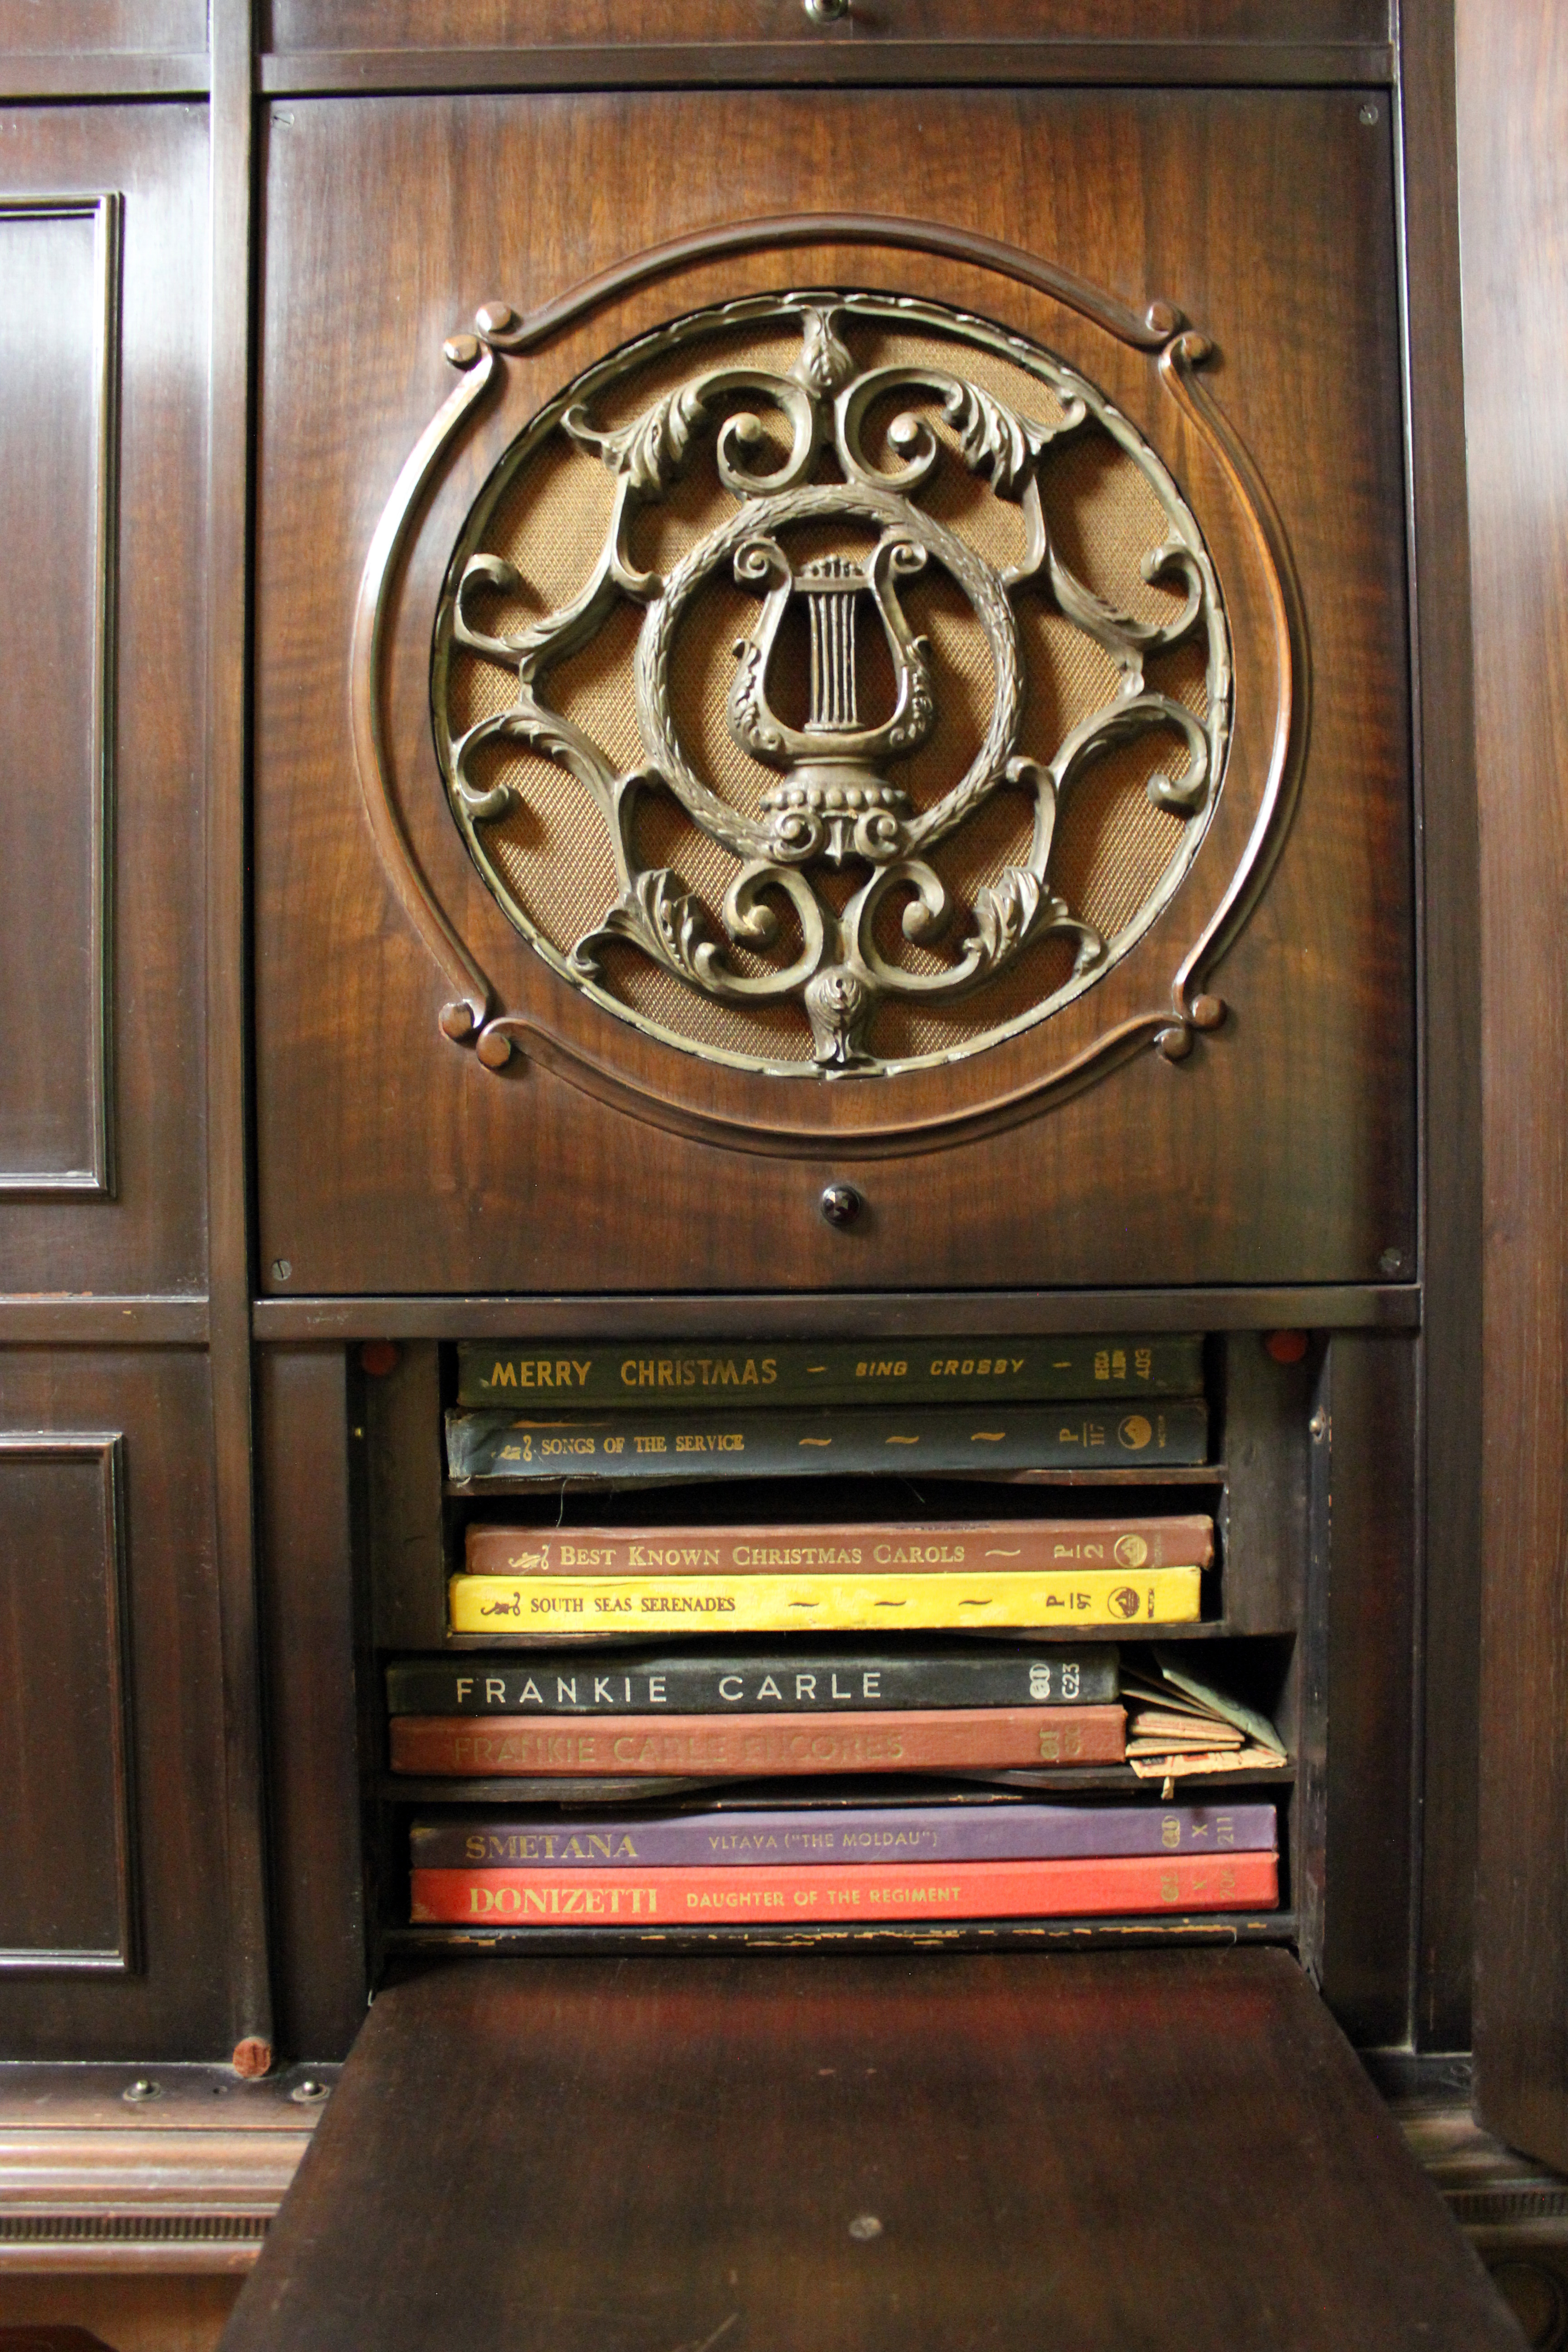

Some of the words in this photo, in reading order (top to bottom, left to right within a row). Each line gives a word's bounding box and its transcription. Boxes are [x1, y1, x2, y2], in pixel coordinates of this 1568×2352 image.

[491, 1361, 591, 1387] MERRY
[621, 1359, 778, 1386] CHRISTMAS
[855, 1361, 907, 1377] BING
[930, 1359, 1026, 1376] CROSBY
[541, 1438, 595, 1455] SONGS
[603, 1437, 625, 1454] OF
[634, 1436, 666, 1452] THE
[676, 1434, 745, 1451] SERVICE
[1059, 1428, 1079, 1442] P
[560, 1545, 617, 1566] BEST
[628, 1545, 720, 1566] KNOWN
[731, 1546, 862, 1566] CHRISTMAS
[873, 1544, 965, 1564] CAROLS
[1054, 1545, 1073, 1558] P
[1084, 1544, 1104, 1559] 2
[530, 1598, 584, 1613] SOUTH
[594, 1597, 632, 1612] SEAS
[641, 1597, 736, 1612] SERENADES
[1046, 1595, 1065, 1607] P
[1077, 1593, 1092, 1610] 97
[456, 1676, 667, 1703] FRANKIE
[718, 1672, 881, 1701] CARLE
[1191, 1823, 1208, 1838] X
[1217, 1817, 1234, 1845] 211
[465, 1834, 639, 1859] SMETANA
[708, 1835, 778, 1849] VLTAVA
[469, 1888, 657, 1914] DONIZETTI
[686, 1891, 784, 1907] DAUGHTER
[793, 1891, 818, 1906] OF
[827, 1890, 861, 1905] THE
[869, 1887, 961, 1904] REGIMENT
